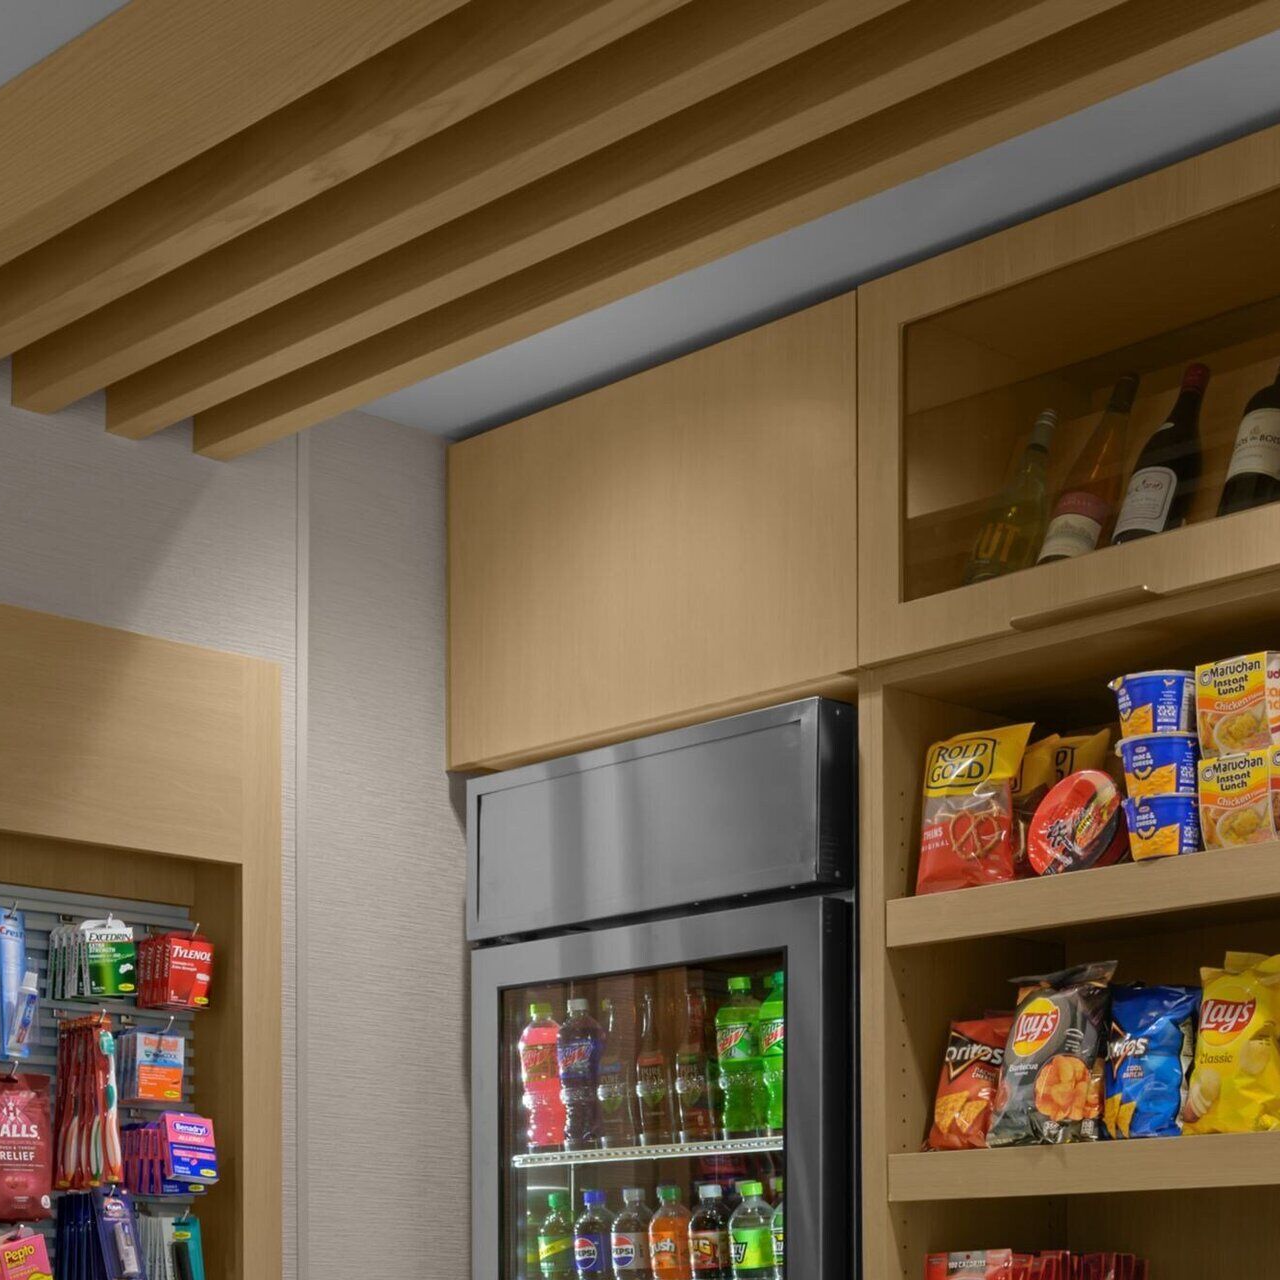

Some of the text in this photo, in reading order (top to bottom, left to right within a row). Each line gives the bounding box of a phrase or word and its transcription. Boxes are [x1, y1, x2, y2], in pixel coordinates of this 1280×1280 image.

[1210, 660, 1260, 678] Maruchan
[1214, 675, 1249, 688] Instant
[1218, 684, 1245, 696] Lunch
[1214, 698, 1246, 711] Chicken
[936, 743, 988, 763] ROLD
[1213, 757, 1263, 773] Maruchan
[931, 762, 984, 783] GOLD
[1217, 771, 1251, 784] Instant
[1221, 780, 1247, 791] Lunch
[1217, 793, 1249, 806] Chicken
[89, 932, 131, 942] EXCEDRIN
[173, 945, 212, 962] TYLENOL
[1200, 1000, 1254, 1033] Lay's
[1017, 1013, 1057, 1041] Lay's
[1200, 1052, 1233, 1064] Classic
[175, 1122, 208, 1135] Benadryl
[0, 1151, 35, 1161] RELIEF
[4, 1244, 34, 1263] Pepto
